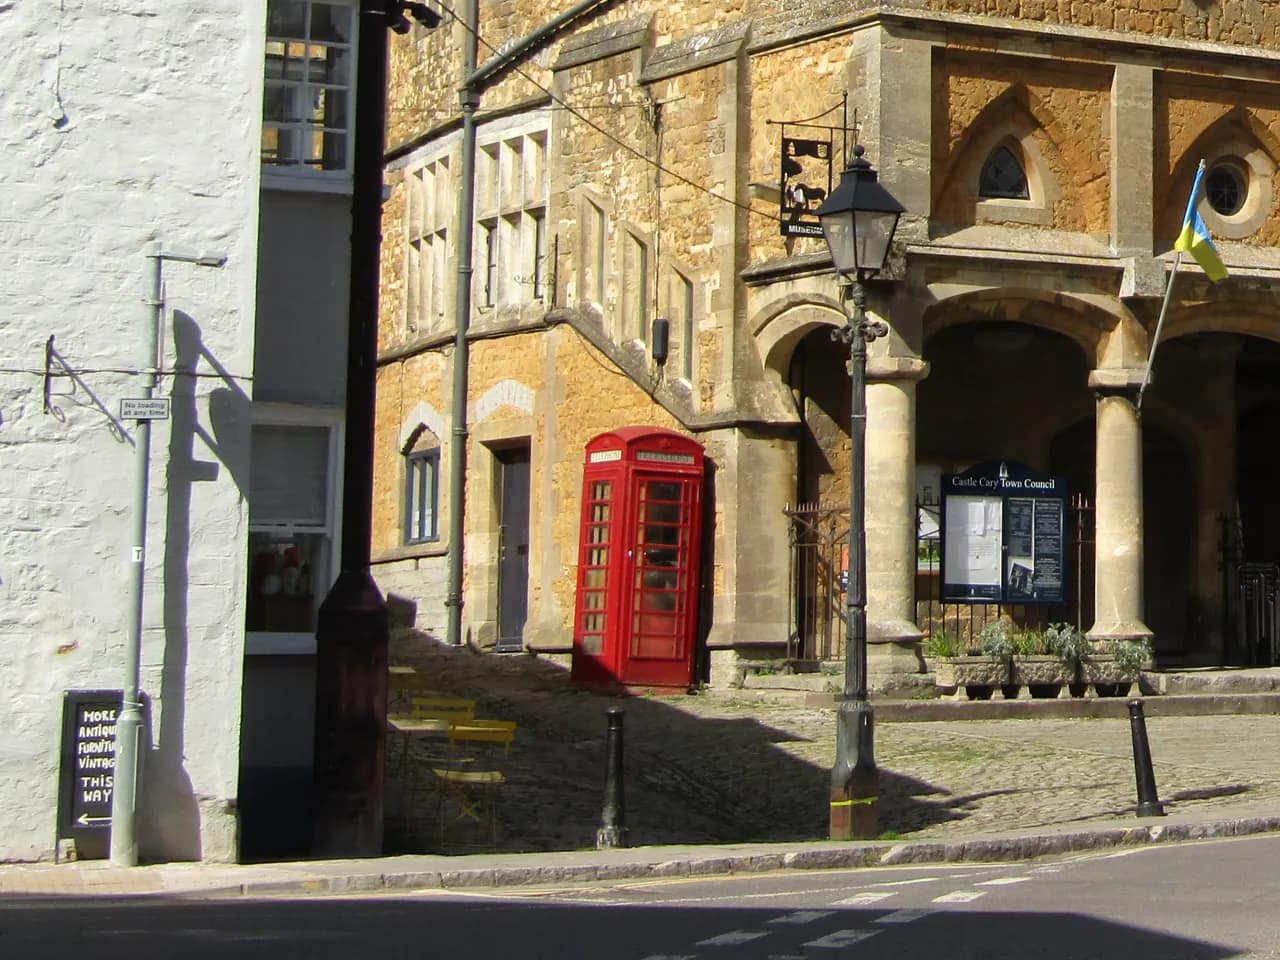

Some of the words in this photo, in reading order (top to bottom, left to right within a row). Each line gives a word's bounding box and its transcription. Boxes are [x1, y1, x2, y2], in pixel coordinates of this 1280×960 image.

[788, 224, 823, 235] MUSEUM
[952, 477, 977, 487] Castle
[979, 477, 999, 490] Cary
[1000, 478, 1022, 488] Town
[1024, 479, 1055, 489] Council
[83, 710, 116, 723] MORE
[79, 724, 118, 738] ANTIQU
[79, 755, 115, 769] VINTAG
[81, 775, 113, 788] THIS
[83, 789, 112, 803] WAY
